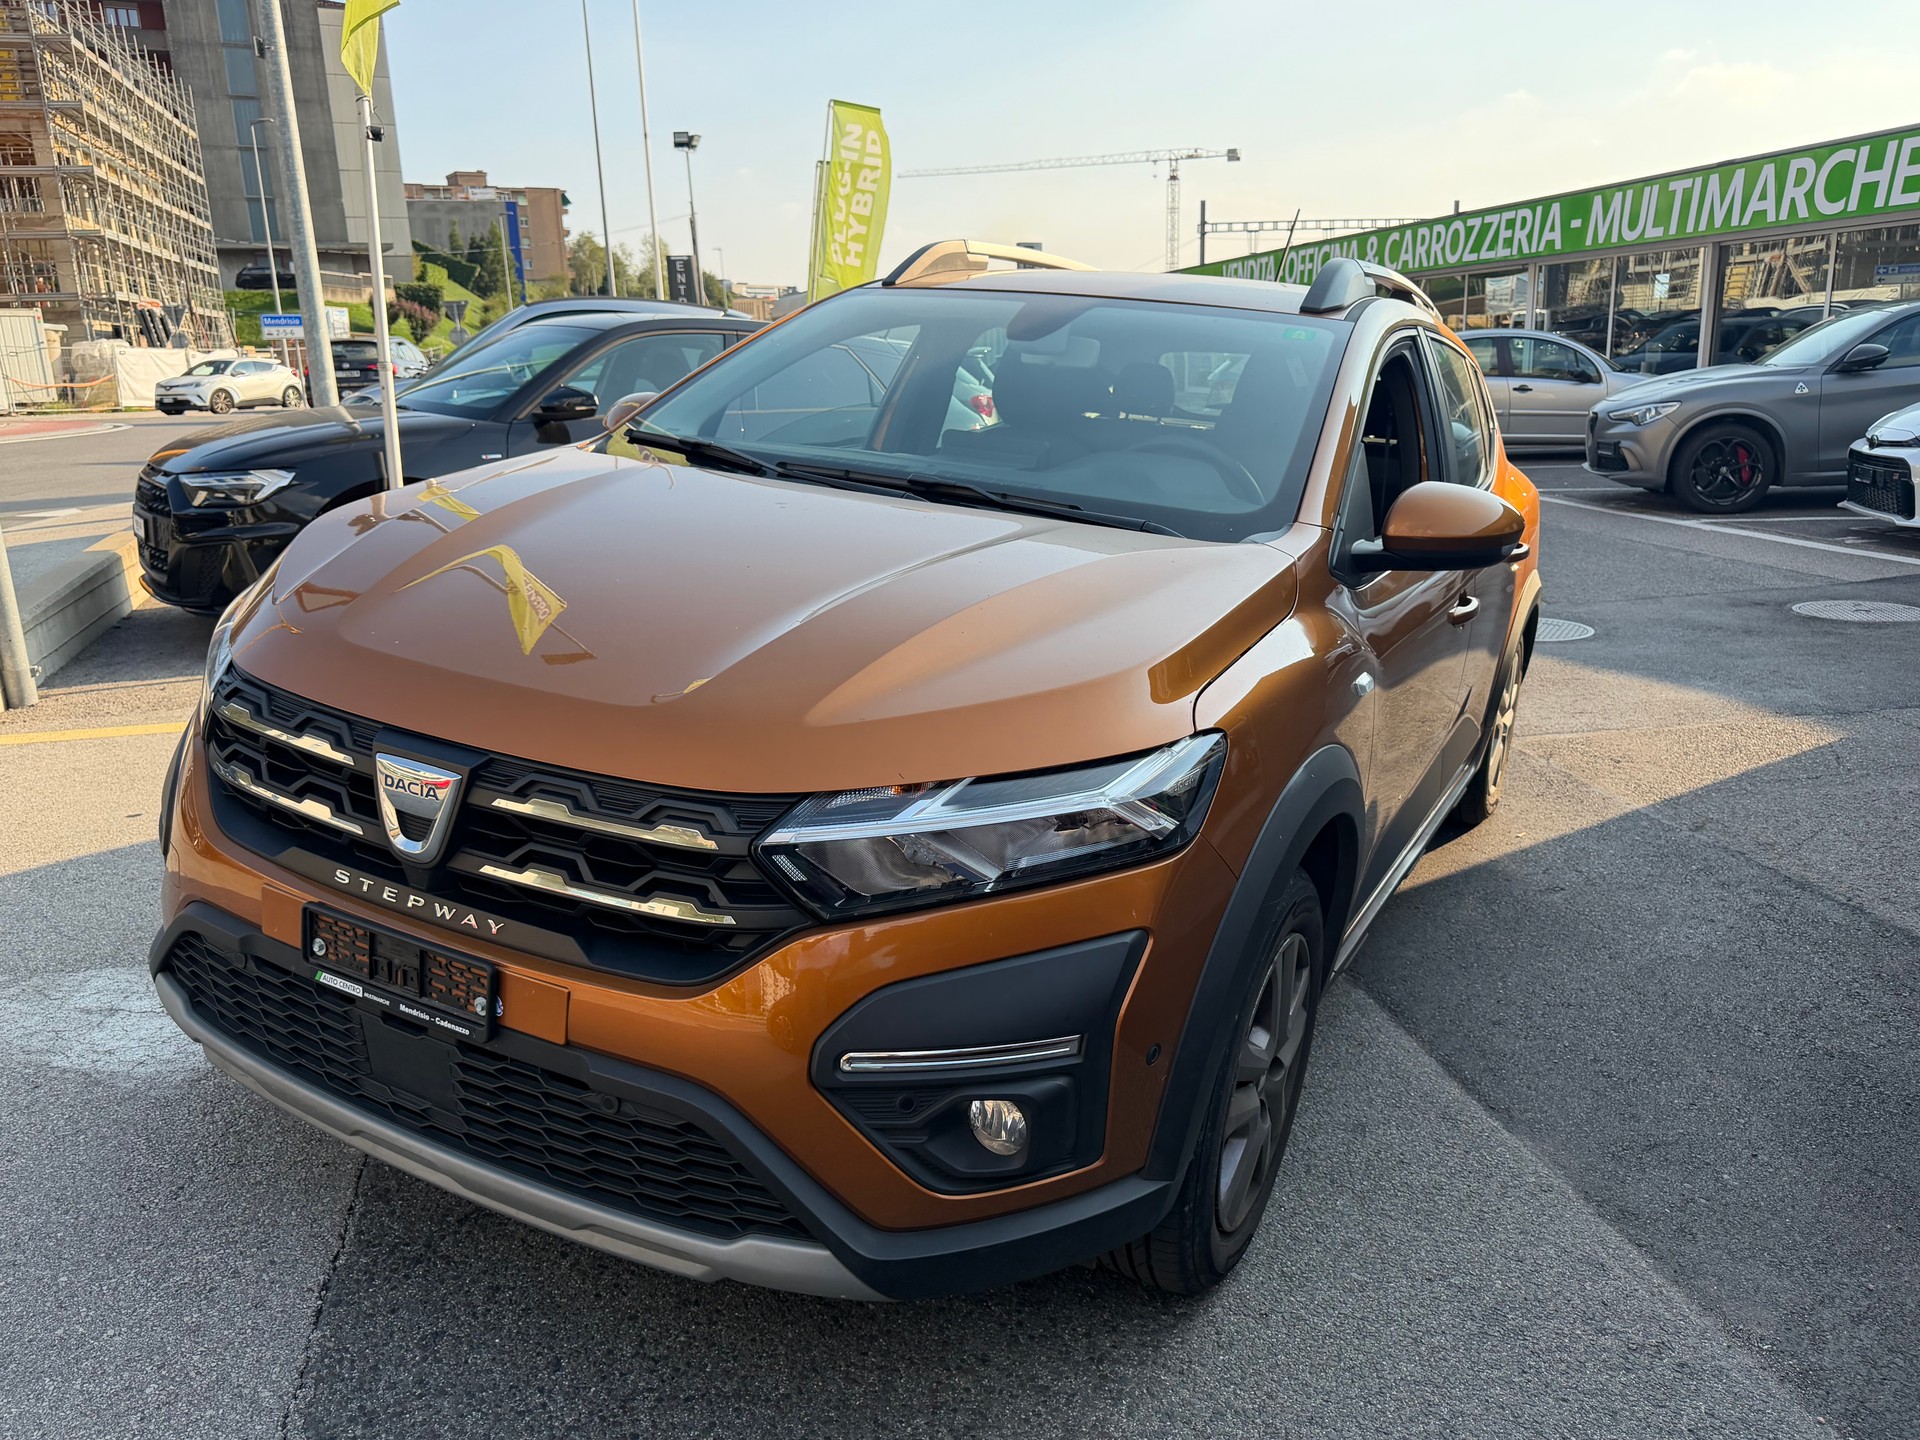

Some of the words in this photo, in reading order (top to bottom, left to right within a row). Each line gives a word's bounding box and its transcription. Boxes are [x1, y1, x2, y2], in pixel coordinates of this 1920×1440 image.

[830, 123, 863, 265] PLUG-IN
[845, 129, 882, 268] HYBRID
[1365, 236, 1379, 264] &
[1384, 202, 1562, 270] CARROZZERIA
[1570, 218, 1582, 228] -
[1585, 136, 1920, 246] MULTIMARCHE
[263, 317, 300, 325] Mendrisio
[384, 773, 439, 801] DACIA
[334, 869, 504, 935] STEPWAY
[322, 974, 338, 986] AUTO
[339, 981, 361, 995] CENTRO
[400, 1003, 430, 1021] Mendrisio
[435, 1017, 470, 1036] Cadenazzo
